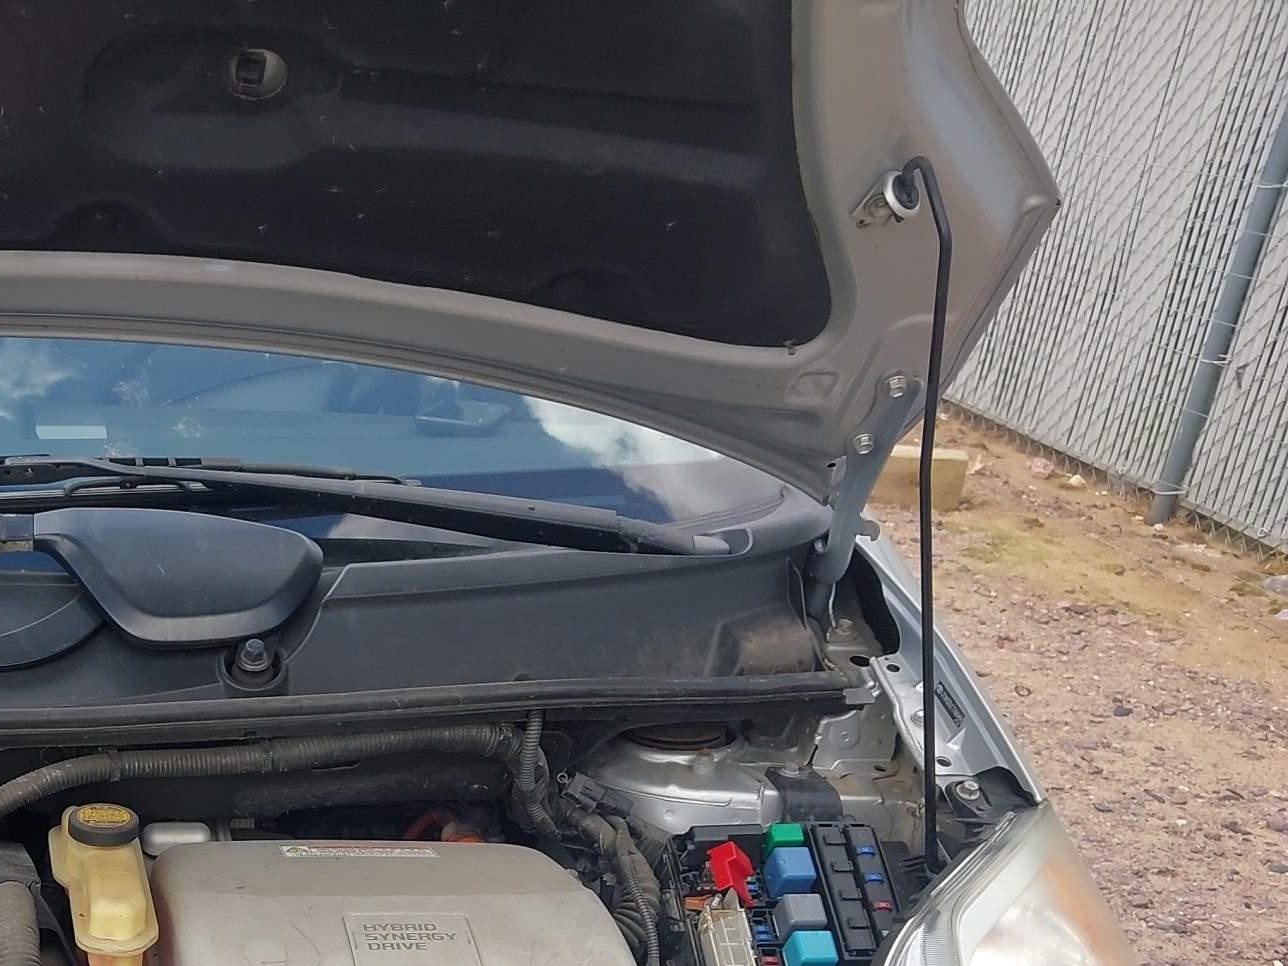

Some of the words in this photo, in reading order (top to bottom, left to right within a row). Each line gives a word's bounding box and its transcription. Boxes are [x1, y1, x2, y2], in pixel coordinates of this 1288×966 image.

[362, 923, 437, 931] HYBRID
[364, 932, 457, 941] SYNERGY
[367, 942, 428, 951] DRIVE
